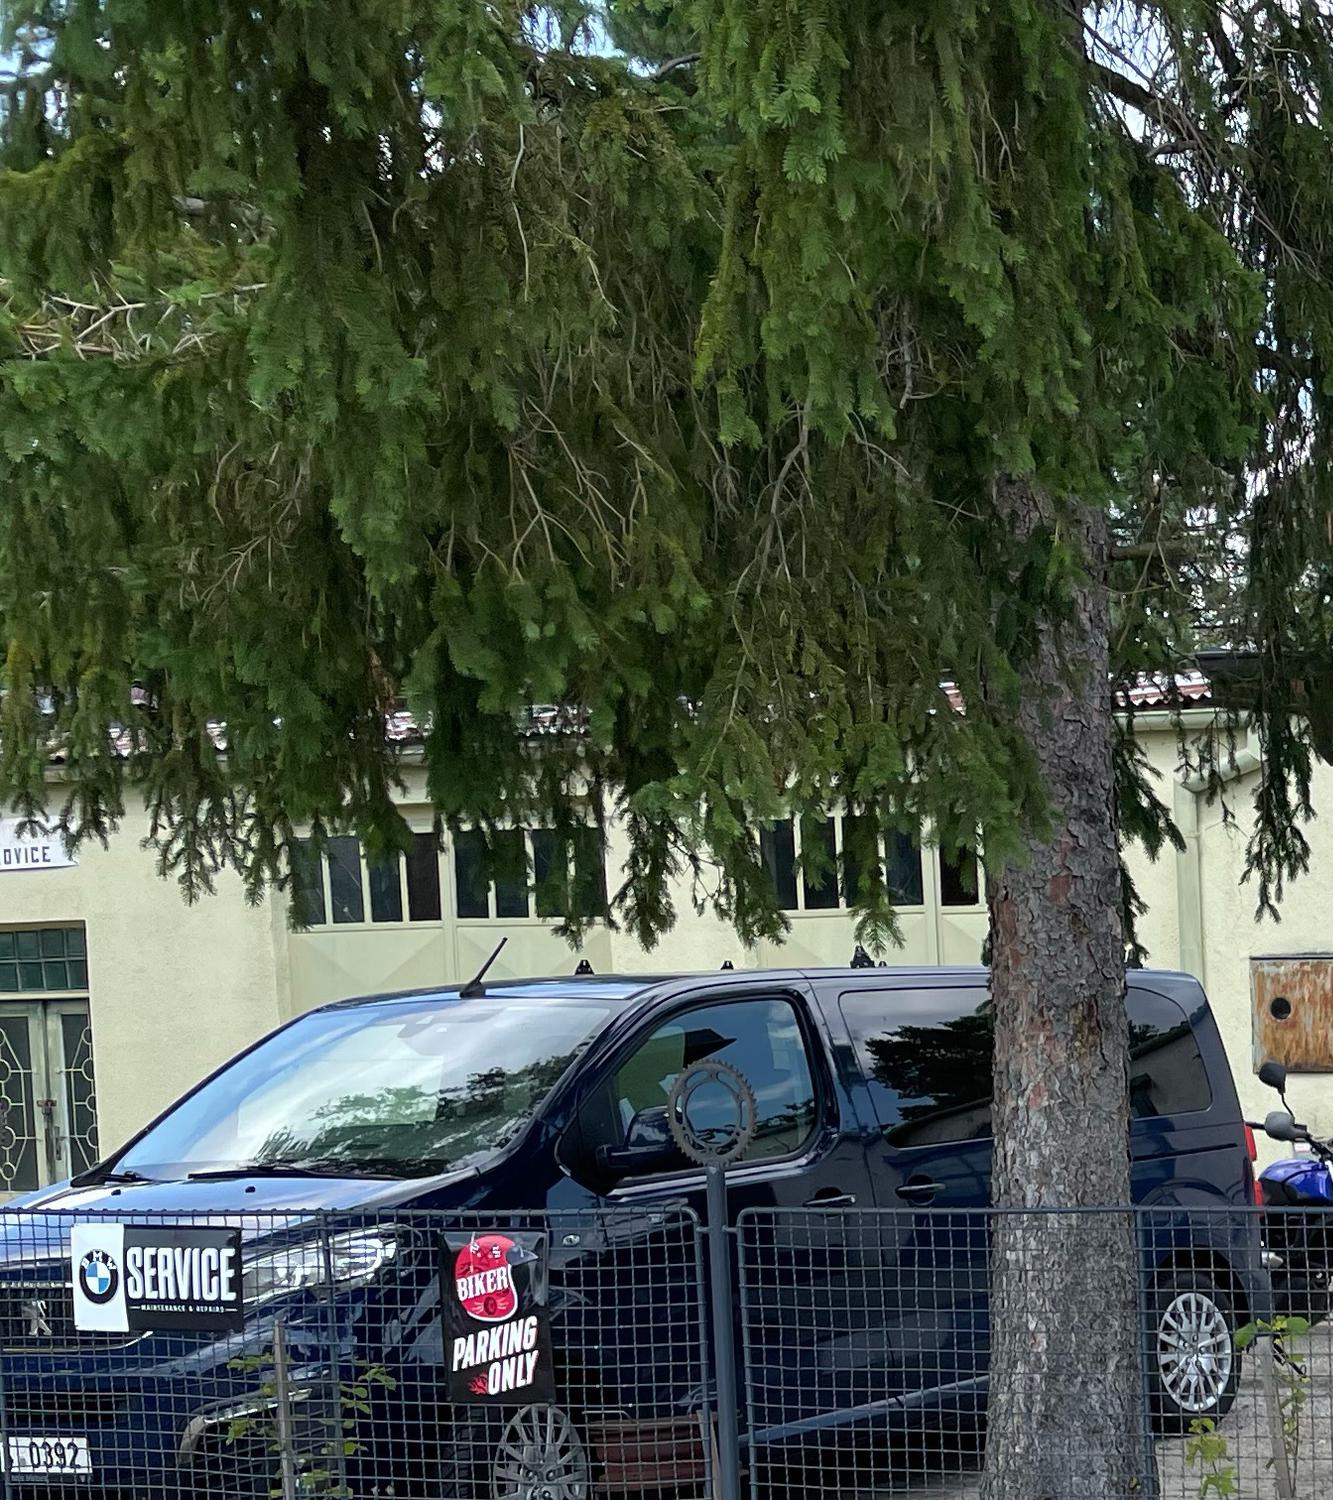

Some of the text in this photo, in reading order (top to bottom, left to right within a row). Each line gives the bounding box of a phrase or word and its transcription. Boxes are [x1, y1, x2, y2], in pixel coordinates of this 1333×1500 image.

[81, 1250, 117, 1270] BMW
[126, 1246, 237, 1301] SERVICE
[456, 1266, 509, 1302] BIKER
[452, 1315, 538, 1372] PARKING
[488, 1350, 539, 1396] ONLY
[29, 1441, 81, 1469] 0392
